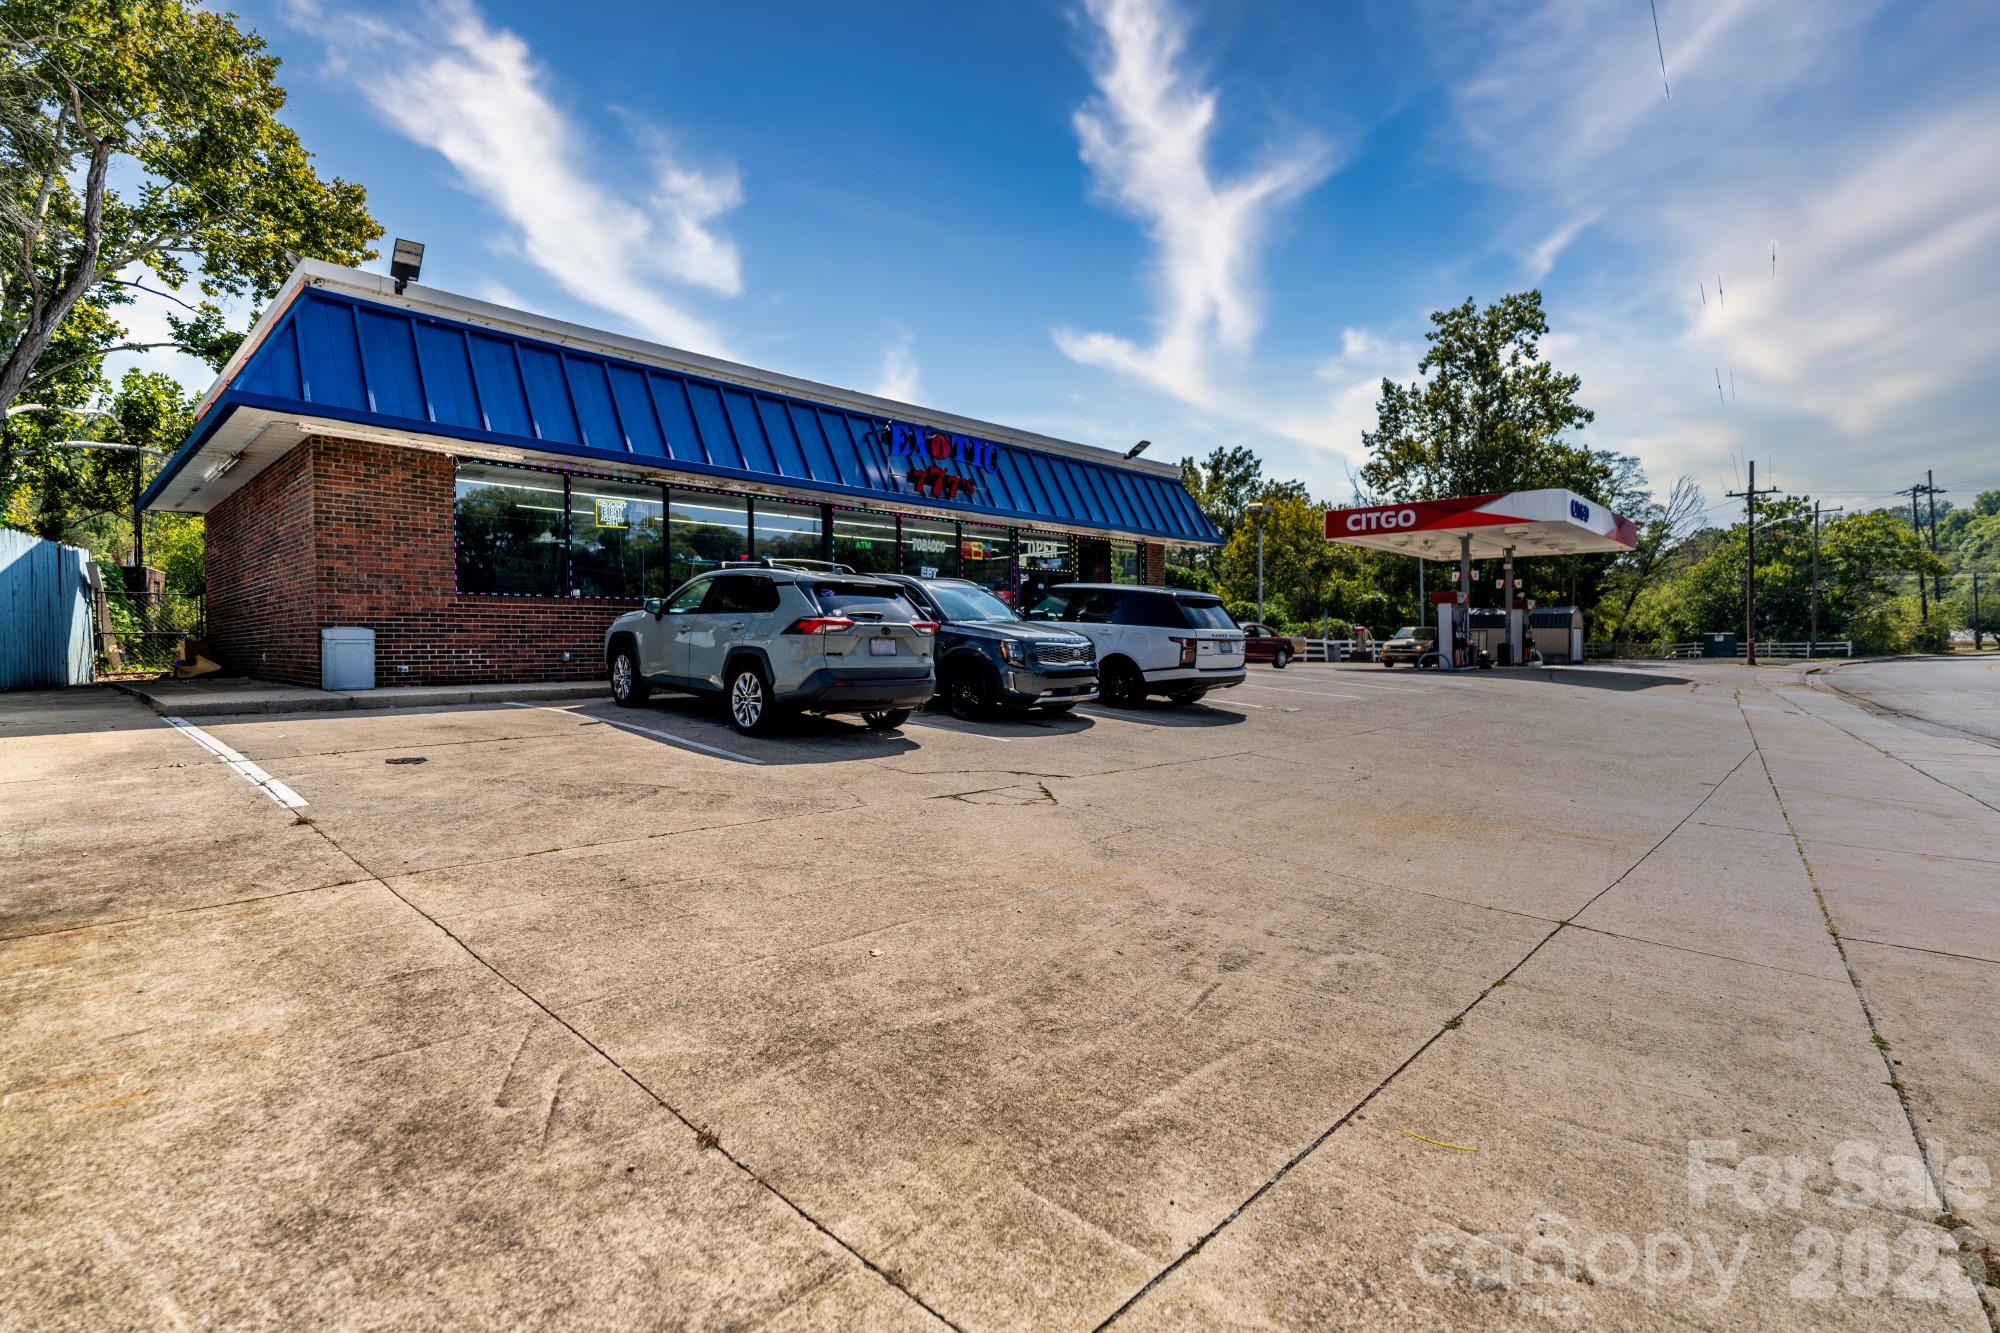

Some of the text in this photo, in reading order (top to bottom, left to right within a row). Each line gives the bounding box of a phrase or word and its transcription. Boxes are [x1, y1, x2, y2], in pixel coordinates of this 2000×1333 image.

[891, 422, 1000, 474] EXOTIC
[602, 507, 624, 517] EBT
[1346, 508, 1416, 531] CITGO
[855, 540, 872, 551] ATM
[912, 538, 946, 554] TOBACCO
[1028, 540, 1058, 558] OPEN
[920, 566, 939, 578] EBT
